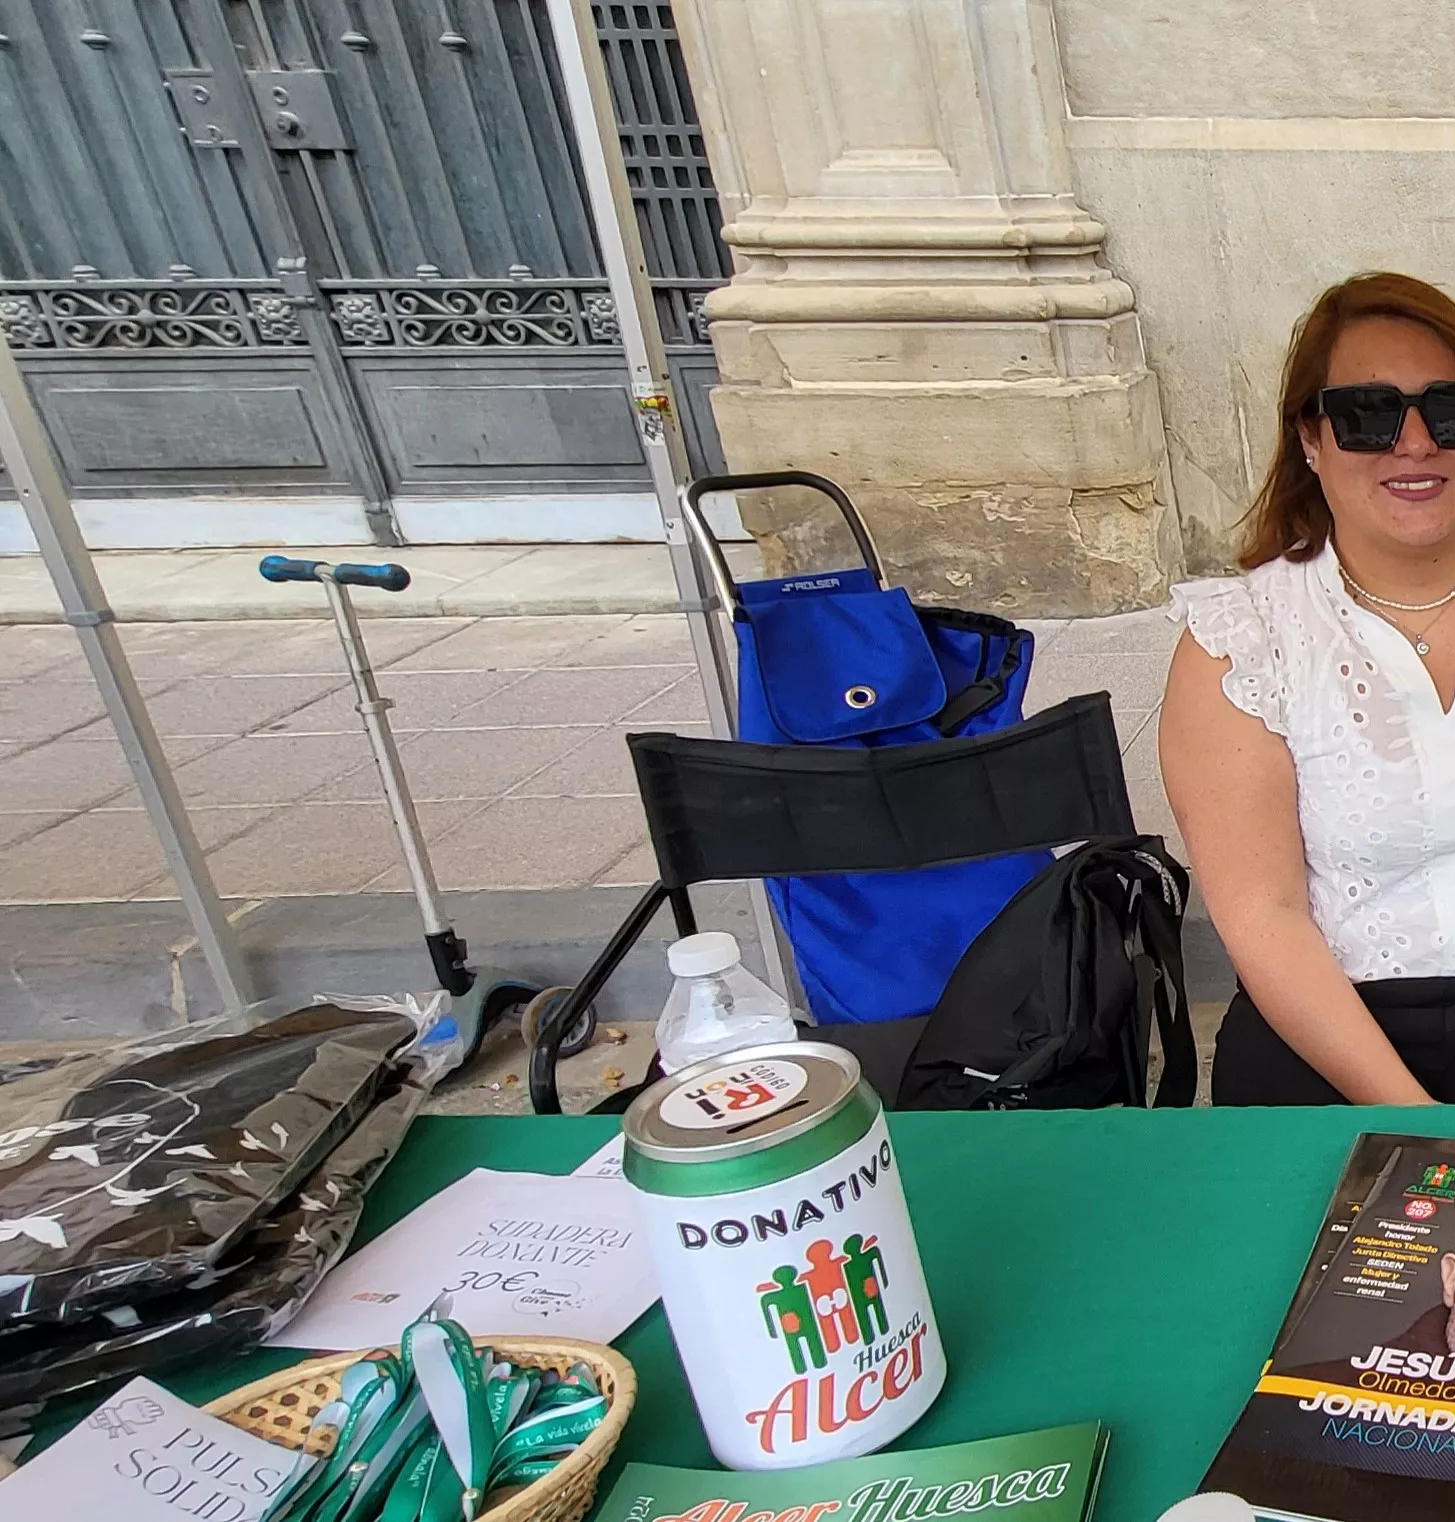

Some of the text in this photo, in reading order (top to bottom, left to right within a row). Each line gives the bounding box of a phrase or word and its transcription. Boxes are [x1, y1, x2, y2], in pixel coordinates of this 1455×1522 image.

[794, 577, 840, 591] ROLSER
[677, 1139, 893, 1250] DONATIVO
[1406, 1208, 1432, 1218] 207
[478, 1219, 633, 1249] SUDADERA
[1378, 1221, 1431, 1234] Presidente
[1353, 1235, 1402, 1249] Alejandro
[1384, 1231, 1416, 1241] honor
[457, 1240, 607, 1268] DONANTE
[1352, 1247, 1429, 1264] Junta Directiva
[1367, 1258, 1405, 1270] SEDEN
[442, 1271, 540, 1293] 30€
[1361, 1268, 1400, 1281] Mujer y
[1343, 1276, 1409, 1291] enfermedad
[1356, 1287, 1386, 1297] renal
[853, 1310, 923, 1373] Huesca
[745, 1323, 927, 1454] Alcer
[547, 1426, 569, 1440] vida
[162, 1428, 285, 1498] PULS
[113, 1448, 260, 1522] SOLID
